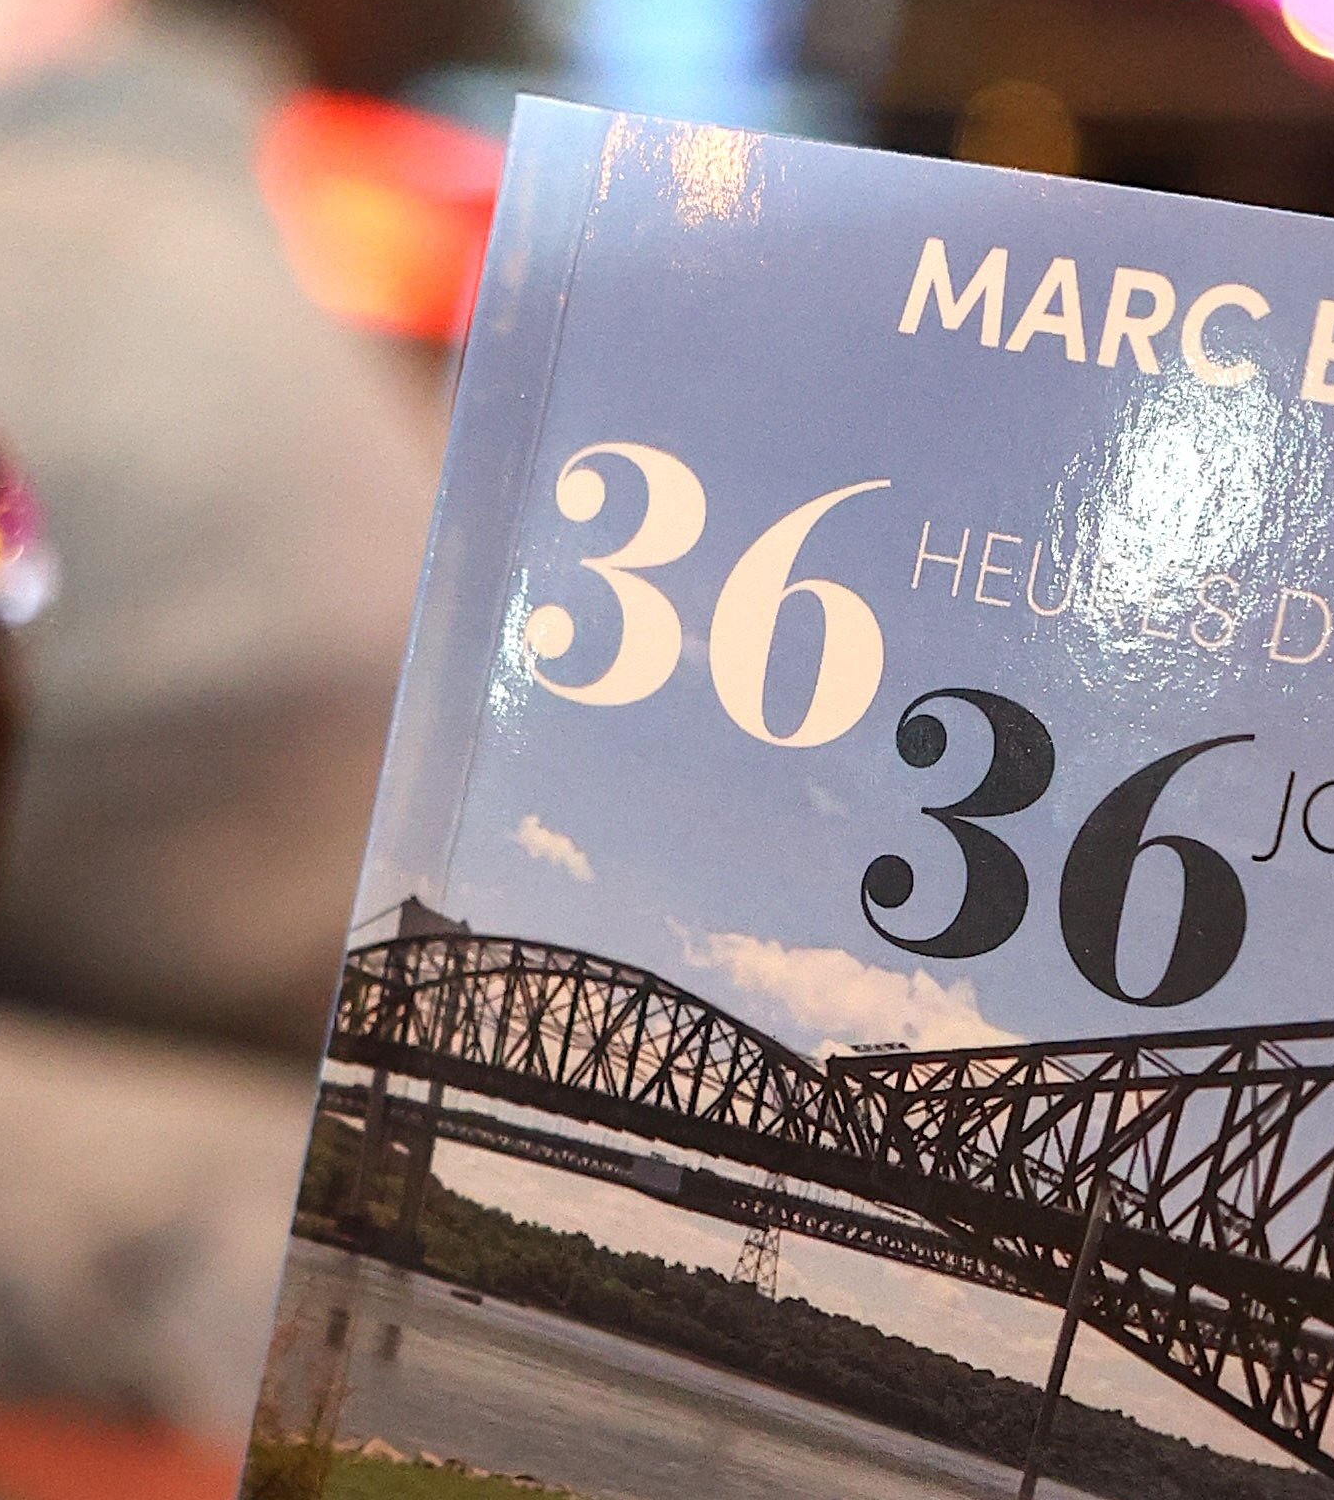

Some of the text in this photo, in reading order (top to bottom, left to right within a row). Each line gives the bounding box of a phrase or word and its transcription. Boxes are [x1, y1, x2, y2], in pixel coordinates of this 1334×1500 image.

[895, 235, 1269, 386] MARC
[525, 440, 893, 749] 36
[857, 685, 1259, 1008] 36
